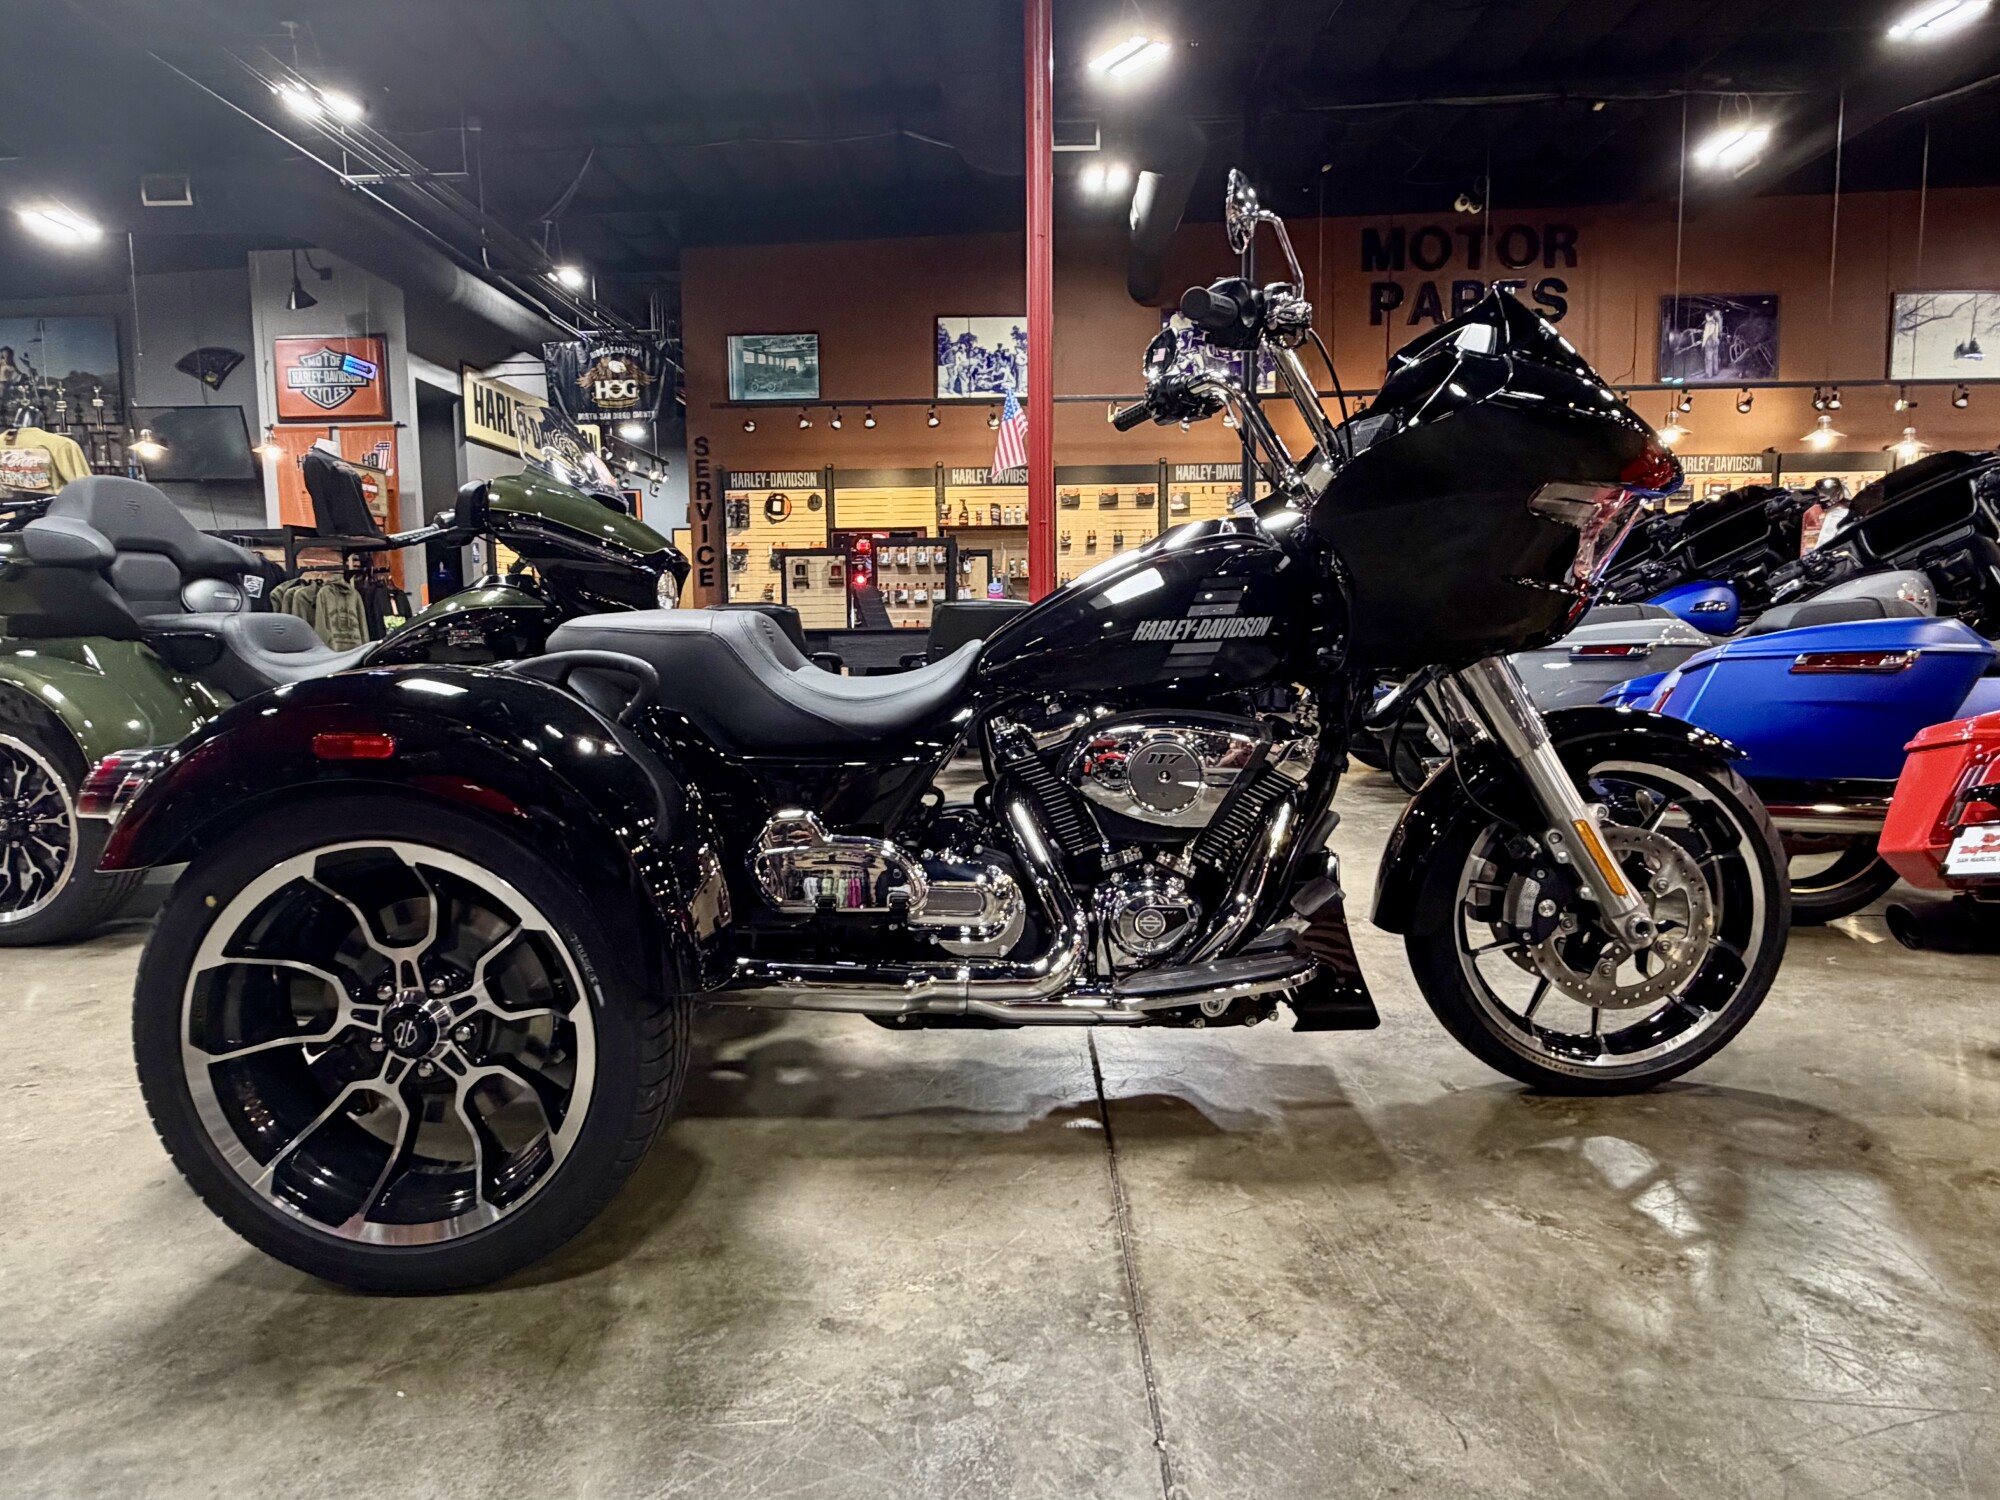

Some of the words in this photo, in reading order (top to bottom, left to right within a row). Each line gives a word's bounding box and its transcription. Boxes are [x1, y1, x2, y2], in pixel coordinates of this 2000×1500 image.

[1361, 223, 1579, 272] MOTOR
[599, 412, 612, 420] SAN
[613, 411, 631, 420] DIEGO
[730, 471, 818, 488] HARLEY-DAVIDSON
[694, 435, 715, 587] SERVICE
[1131, 616, 1274, 641] HARLEY-DAVIDSON
[1145, 752, 1186, 766] 117
